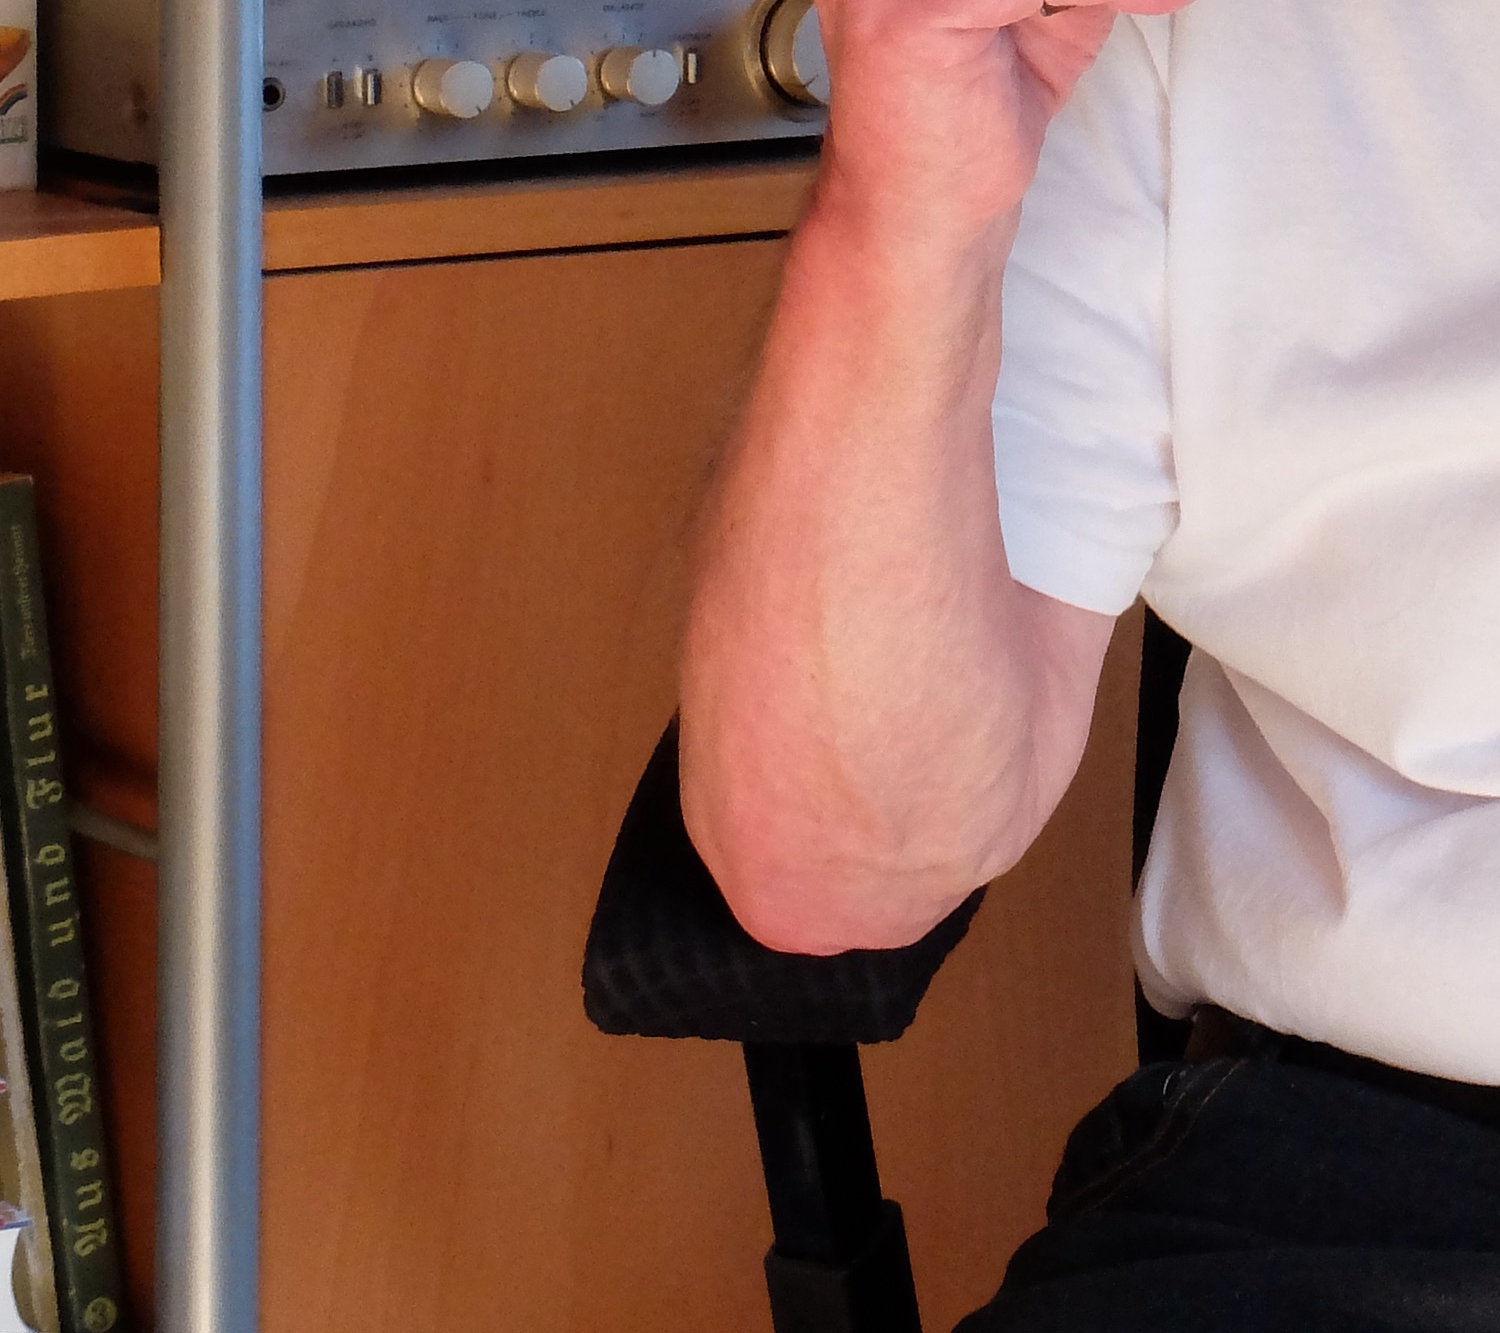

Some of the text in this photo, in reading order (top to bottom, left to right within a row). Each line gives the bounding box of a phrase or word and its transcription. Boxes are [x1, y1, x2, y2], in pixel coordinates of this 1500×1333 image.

[25, 683, 108, 1258] Aus Wald und Flur
